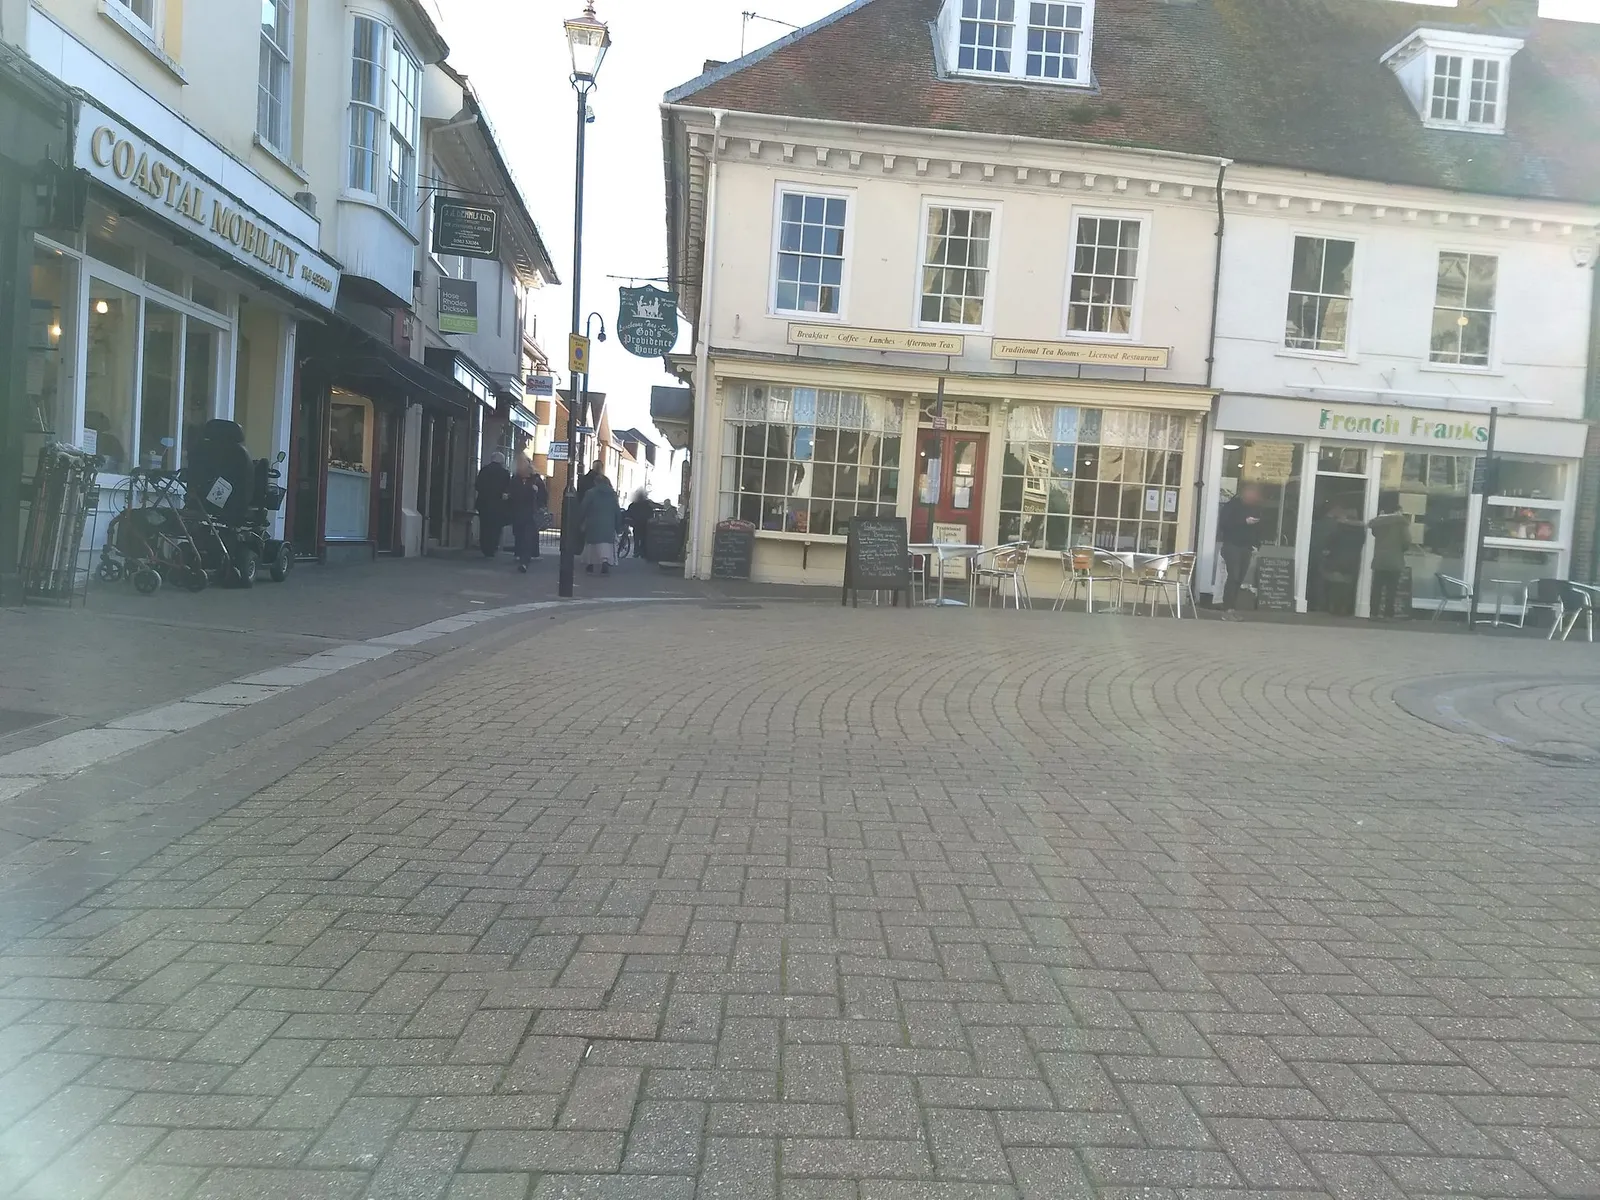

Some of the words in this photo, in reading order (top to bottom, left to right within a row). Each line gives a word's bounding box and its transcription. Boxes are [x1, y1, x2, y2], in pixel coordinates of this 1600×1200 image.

[91, 126, 206, 225] COASTAL
[209, 200, 300, 279] MOBILITY
[442, 291, 460, 300] Hose
[442, 298, 468, 307] Rhodes
[442, 305, 469, 314] Dickson
[635, 328, 662, 337] God's
[624, 334, 673, 348] Providence
[796, 330, 830, 342] Breakfast
[837, 333, 859, 344] Coffee
[868, 336, 896, 345] Lunches
[904, 339, 937, 349] Afternoon
[939, 341, 955, 349] Teas
[634, 344, 663, 355] House
[1000, 345, 1040, 356] Traditional
[1042, 347, 1054, 356] Tea
[1056, 348, 1080, 357] Rooms
[1088, 350, 1119, 360] Licensed
[1121, 353, 1160, 362] Restaurant
[1318, 408, 1400, 436] French
[1410, 415, 1489, 443] Franks
